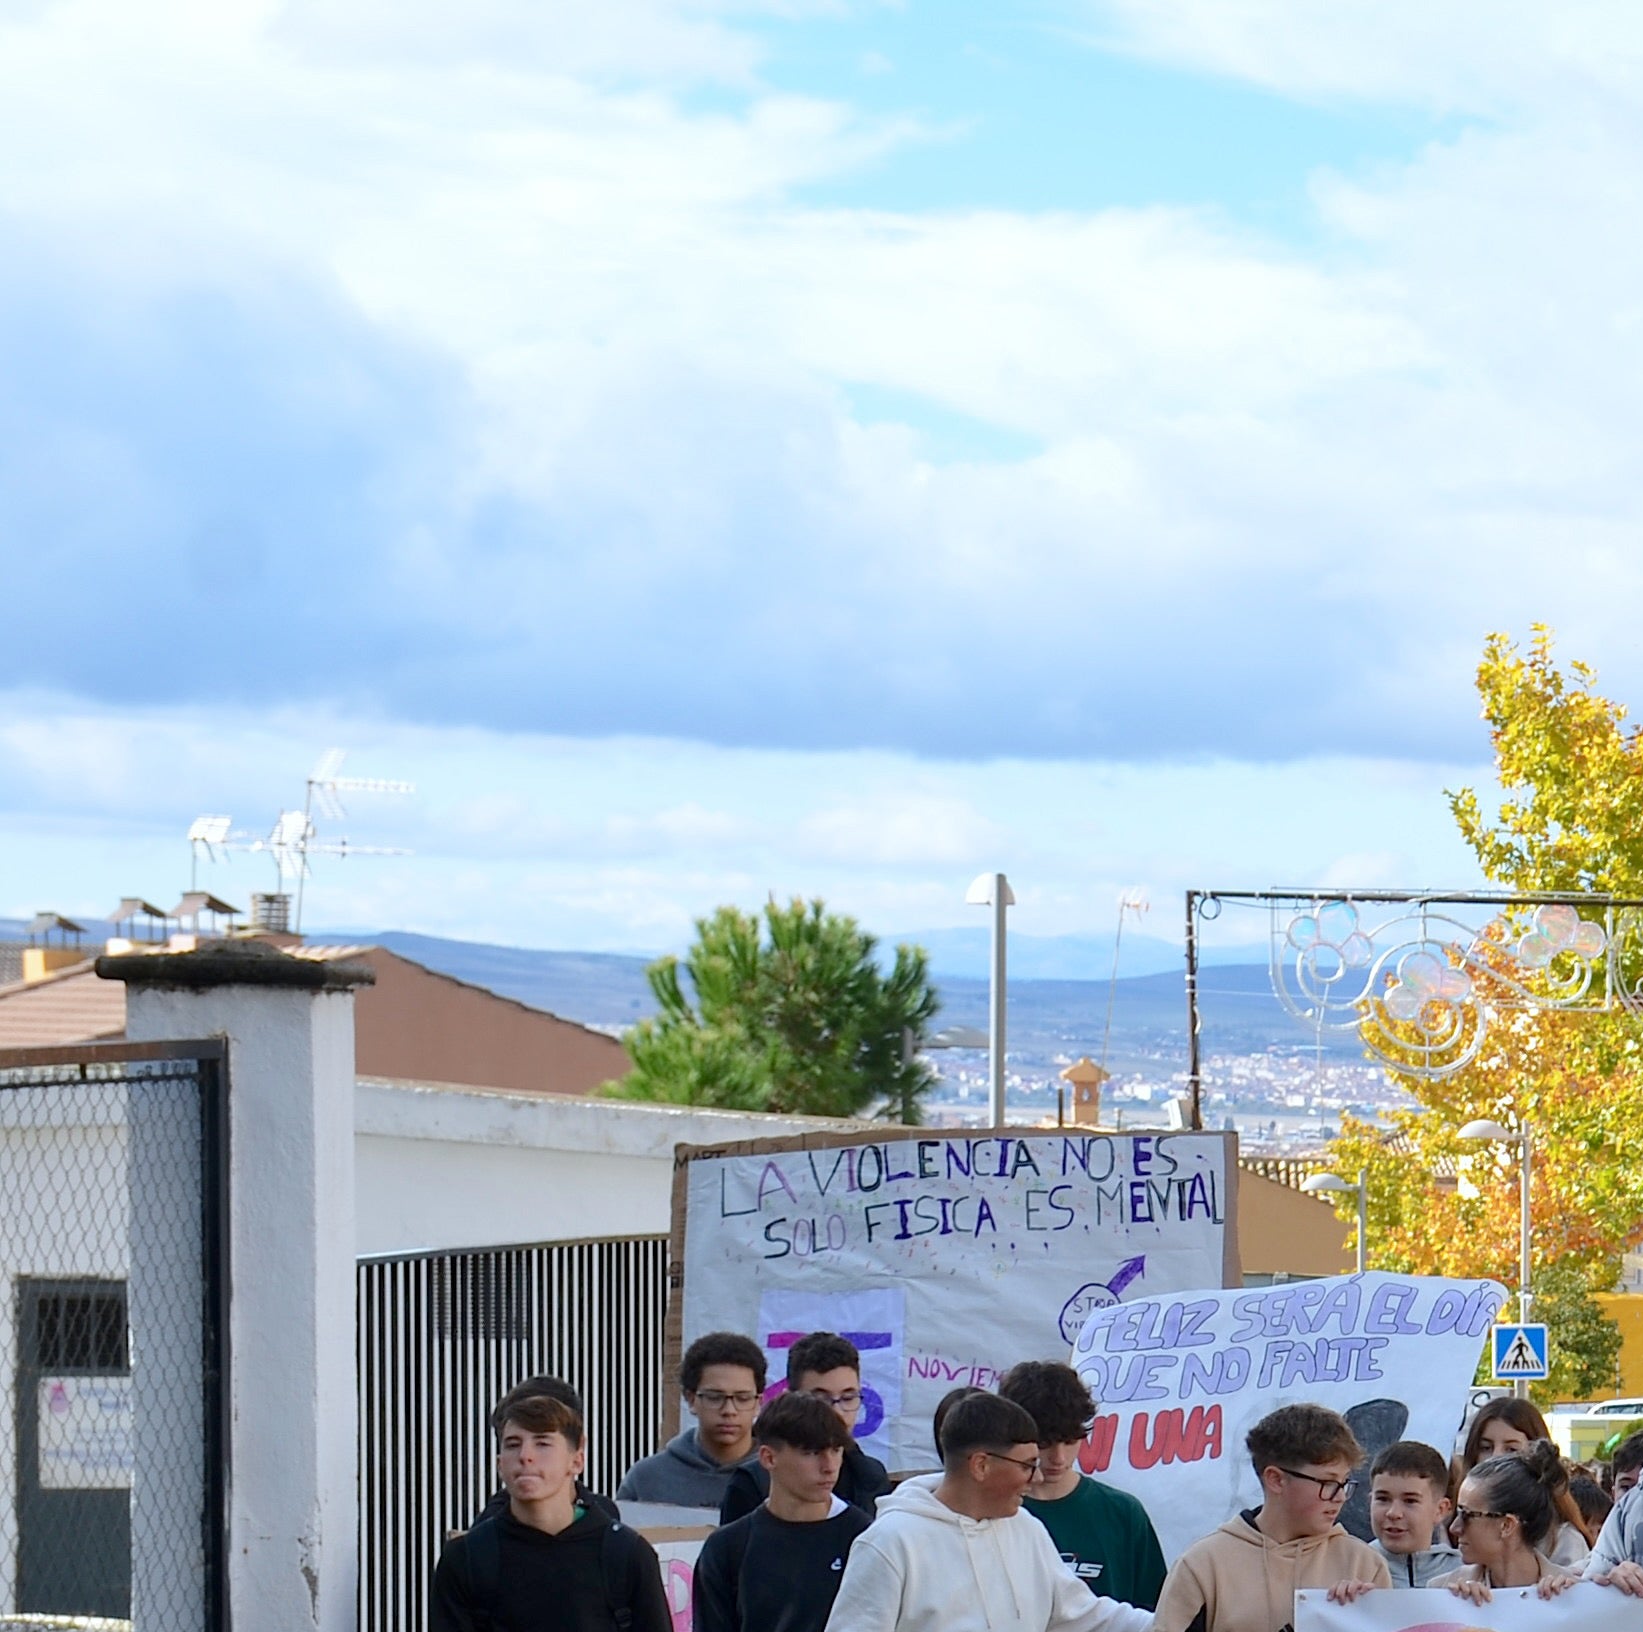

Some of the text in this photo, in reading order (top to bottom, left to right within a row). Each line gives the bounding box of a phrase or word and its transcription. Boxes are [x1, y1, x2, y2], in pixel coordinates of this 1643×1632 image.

[721, 1136, 1178, 1217] LA VIOLENCIA NO ES
[764, 1170, 1224, 1259] SOLO FISICA ES MENTAL
[1077, 1271, 1503, 1353] FELIZ SERÁ EL DÍA
[1074, 1337, 1390, 1404] QUE NO FALTE
[1128, 1404, 1222, 1470] UNA
